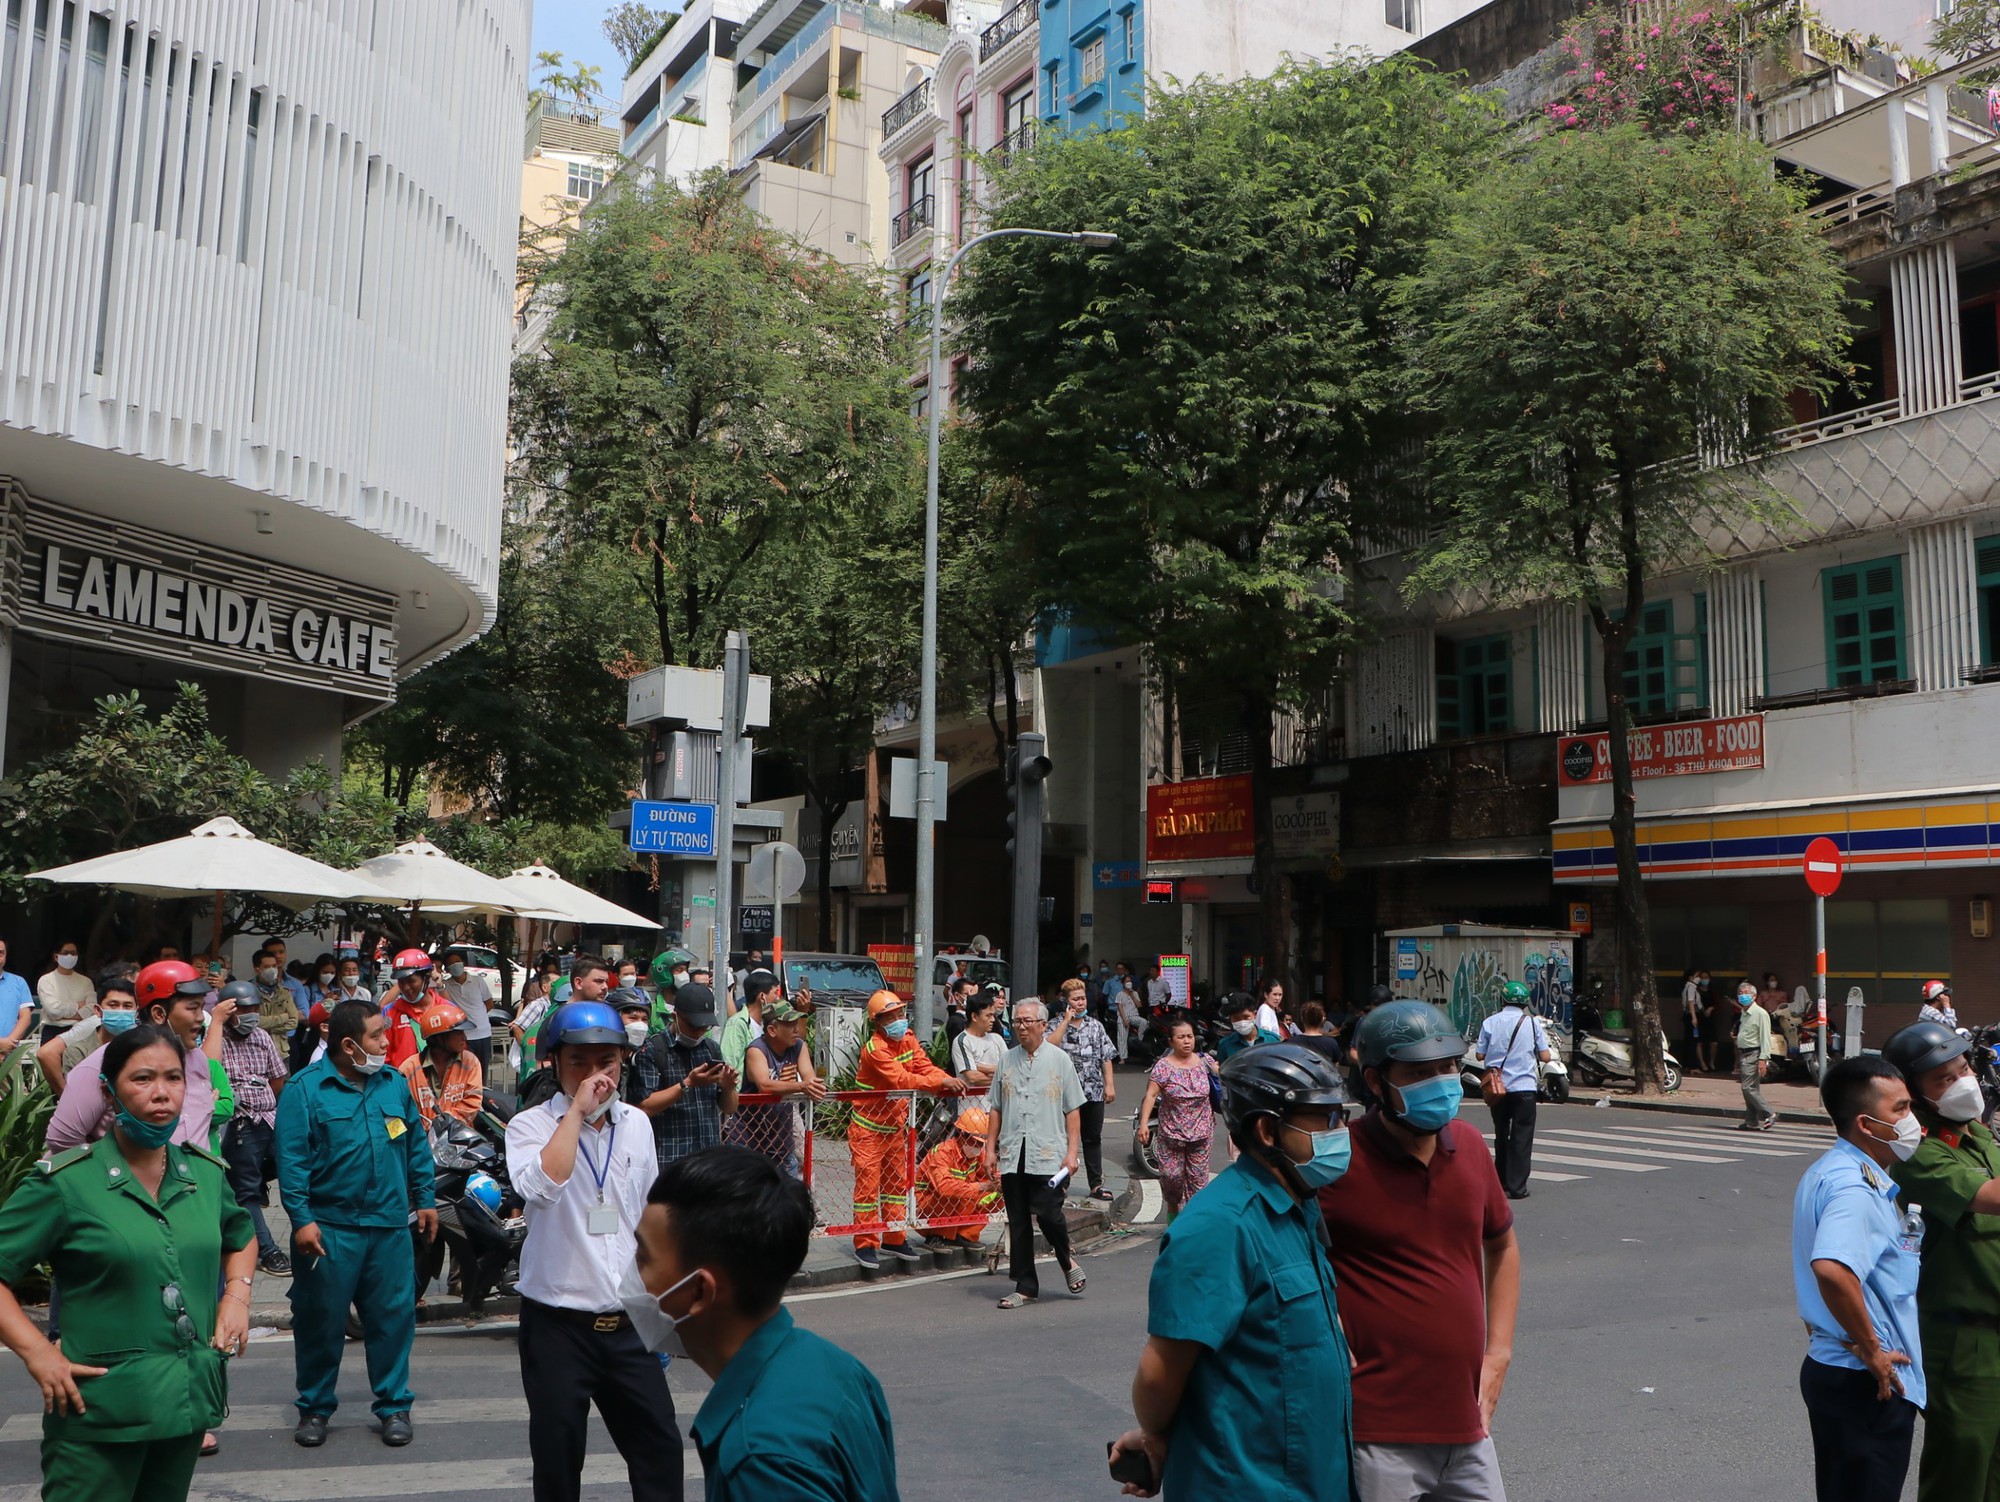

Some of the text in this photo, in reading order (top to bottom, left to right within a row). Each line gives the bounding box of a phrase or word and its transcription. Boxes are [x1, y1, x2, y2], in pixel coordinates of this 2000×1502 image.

[43, 545, 393, 678] LAMENDA CAFE
[1597, 733, 1653, 766] CFEE
[1663, 727, 1705, 758] BEER
[1716, 720, 1760, 753] FOOD
[1564, 756, 1593, 766] COCOPHI
[1642, 764, 1666, 776] Floor)
[1674, 762, 1685, 773] 36
[1688, 757, 1705, 771] THỦ
[1709, 758, 1732, 769] KHOA
[1736, 754, 1761, 766] HUÂN
[649, 808, 697, 824] ĐƯỜNG
[1156, 803, 1246, 839] HÀ ĐẠI PHÁT
[1274, 811, 1327, 829] COCOPHI
[635, 825, 708, 851] LÝ TỰ TRỌNG
[831, 824, 860, 846] GUYỄN
[742, 916, 771, 929] ĐỨC
[1162, 957, 1187, 966] MASSAGE
